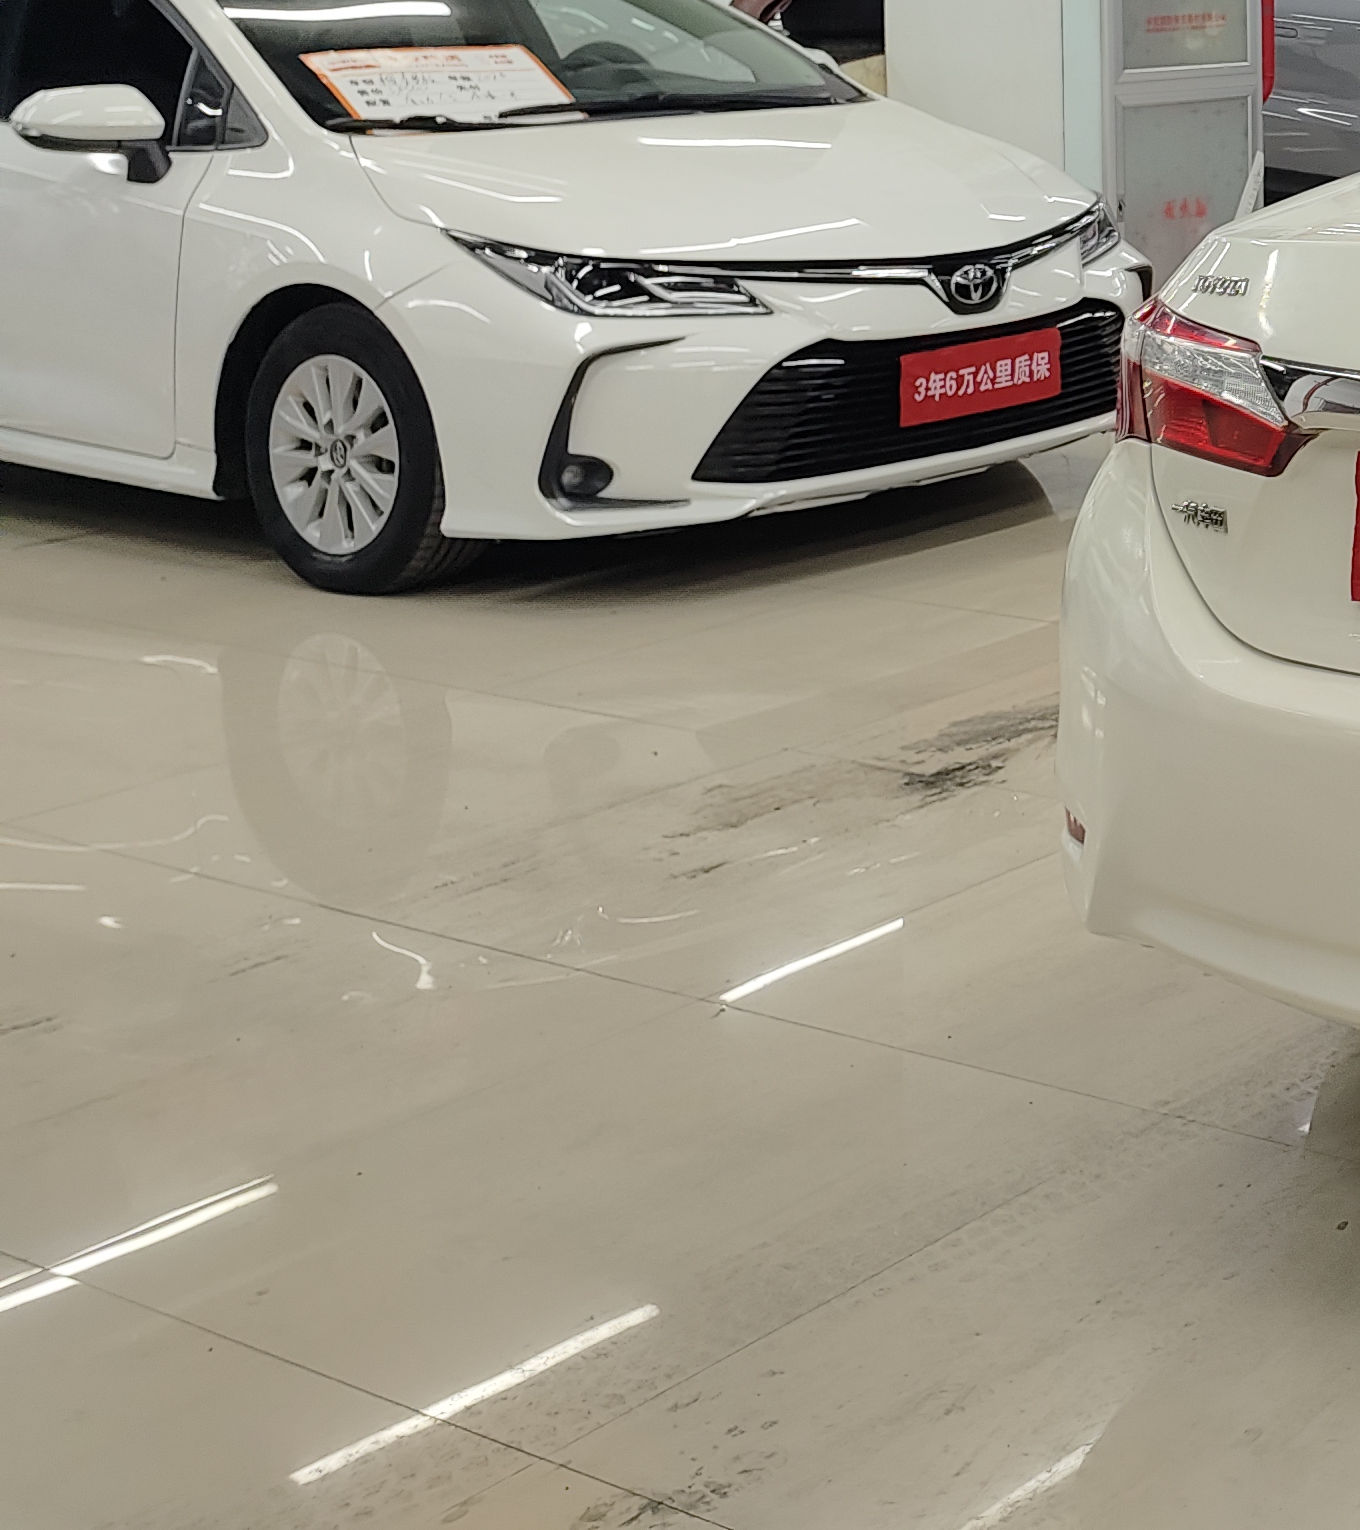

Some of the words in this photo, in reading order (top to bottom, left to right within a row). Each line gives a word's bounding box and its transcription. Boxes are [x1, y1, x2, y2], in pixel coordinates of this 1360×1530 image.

[914, 351, 1051, 402] 3年6万公里质保
